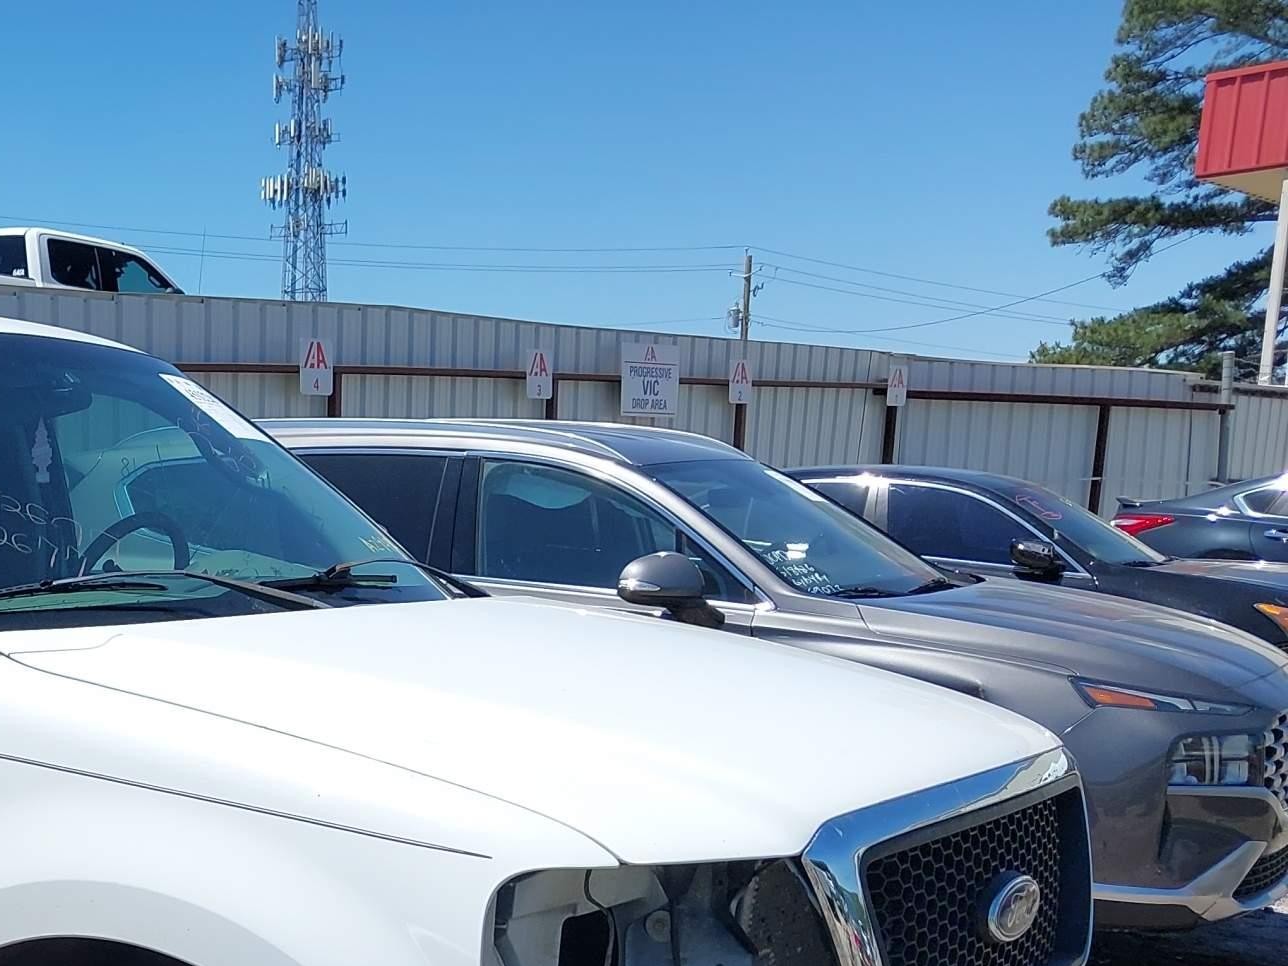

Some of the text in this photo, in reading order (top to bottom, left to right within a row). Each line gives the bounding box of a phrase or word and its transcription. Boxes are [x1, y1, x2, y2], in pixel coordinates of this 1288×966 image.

[629, 365, 672, 380] PROGRESSIVE
[313, 376, 320, 392] 4
[536, 383, 543, 397] 3
[641, 379, 660, 397] VIC
[737, 389, 744, 402] 2
[631, 397, 668, 411] DROP AREA
